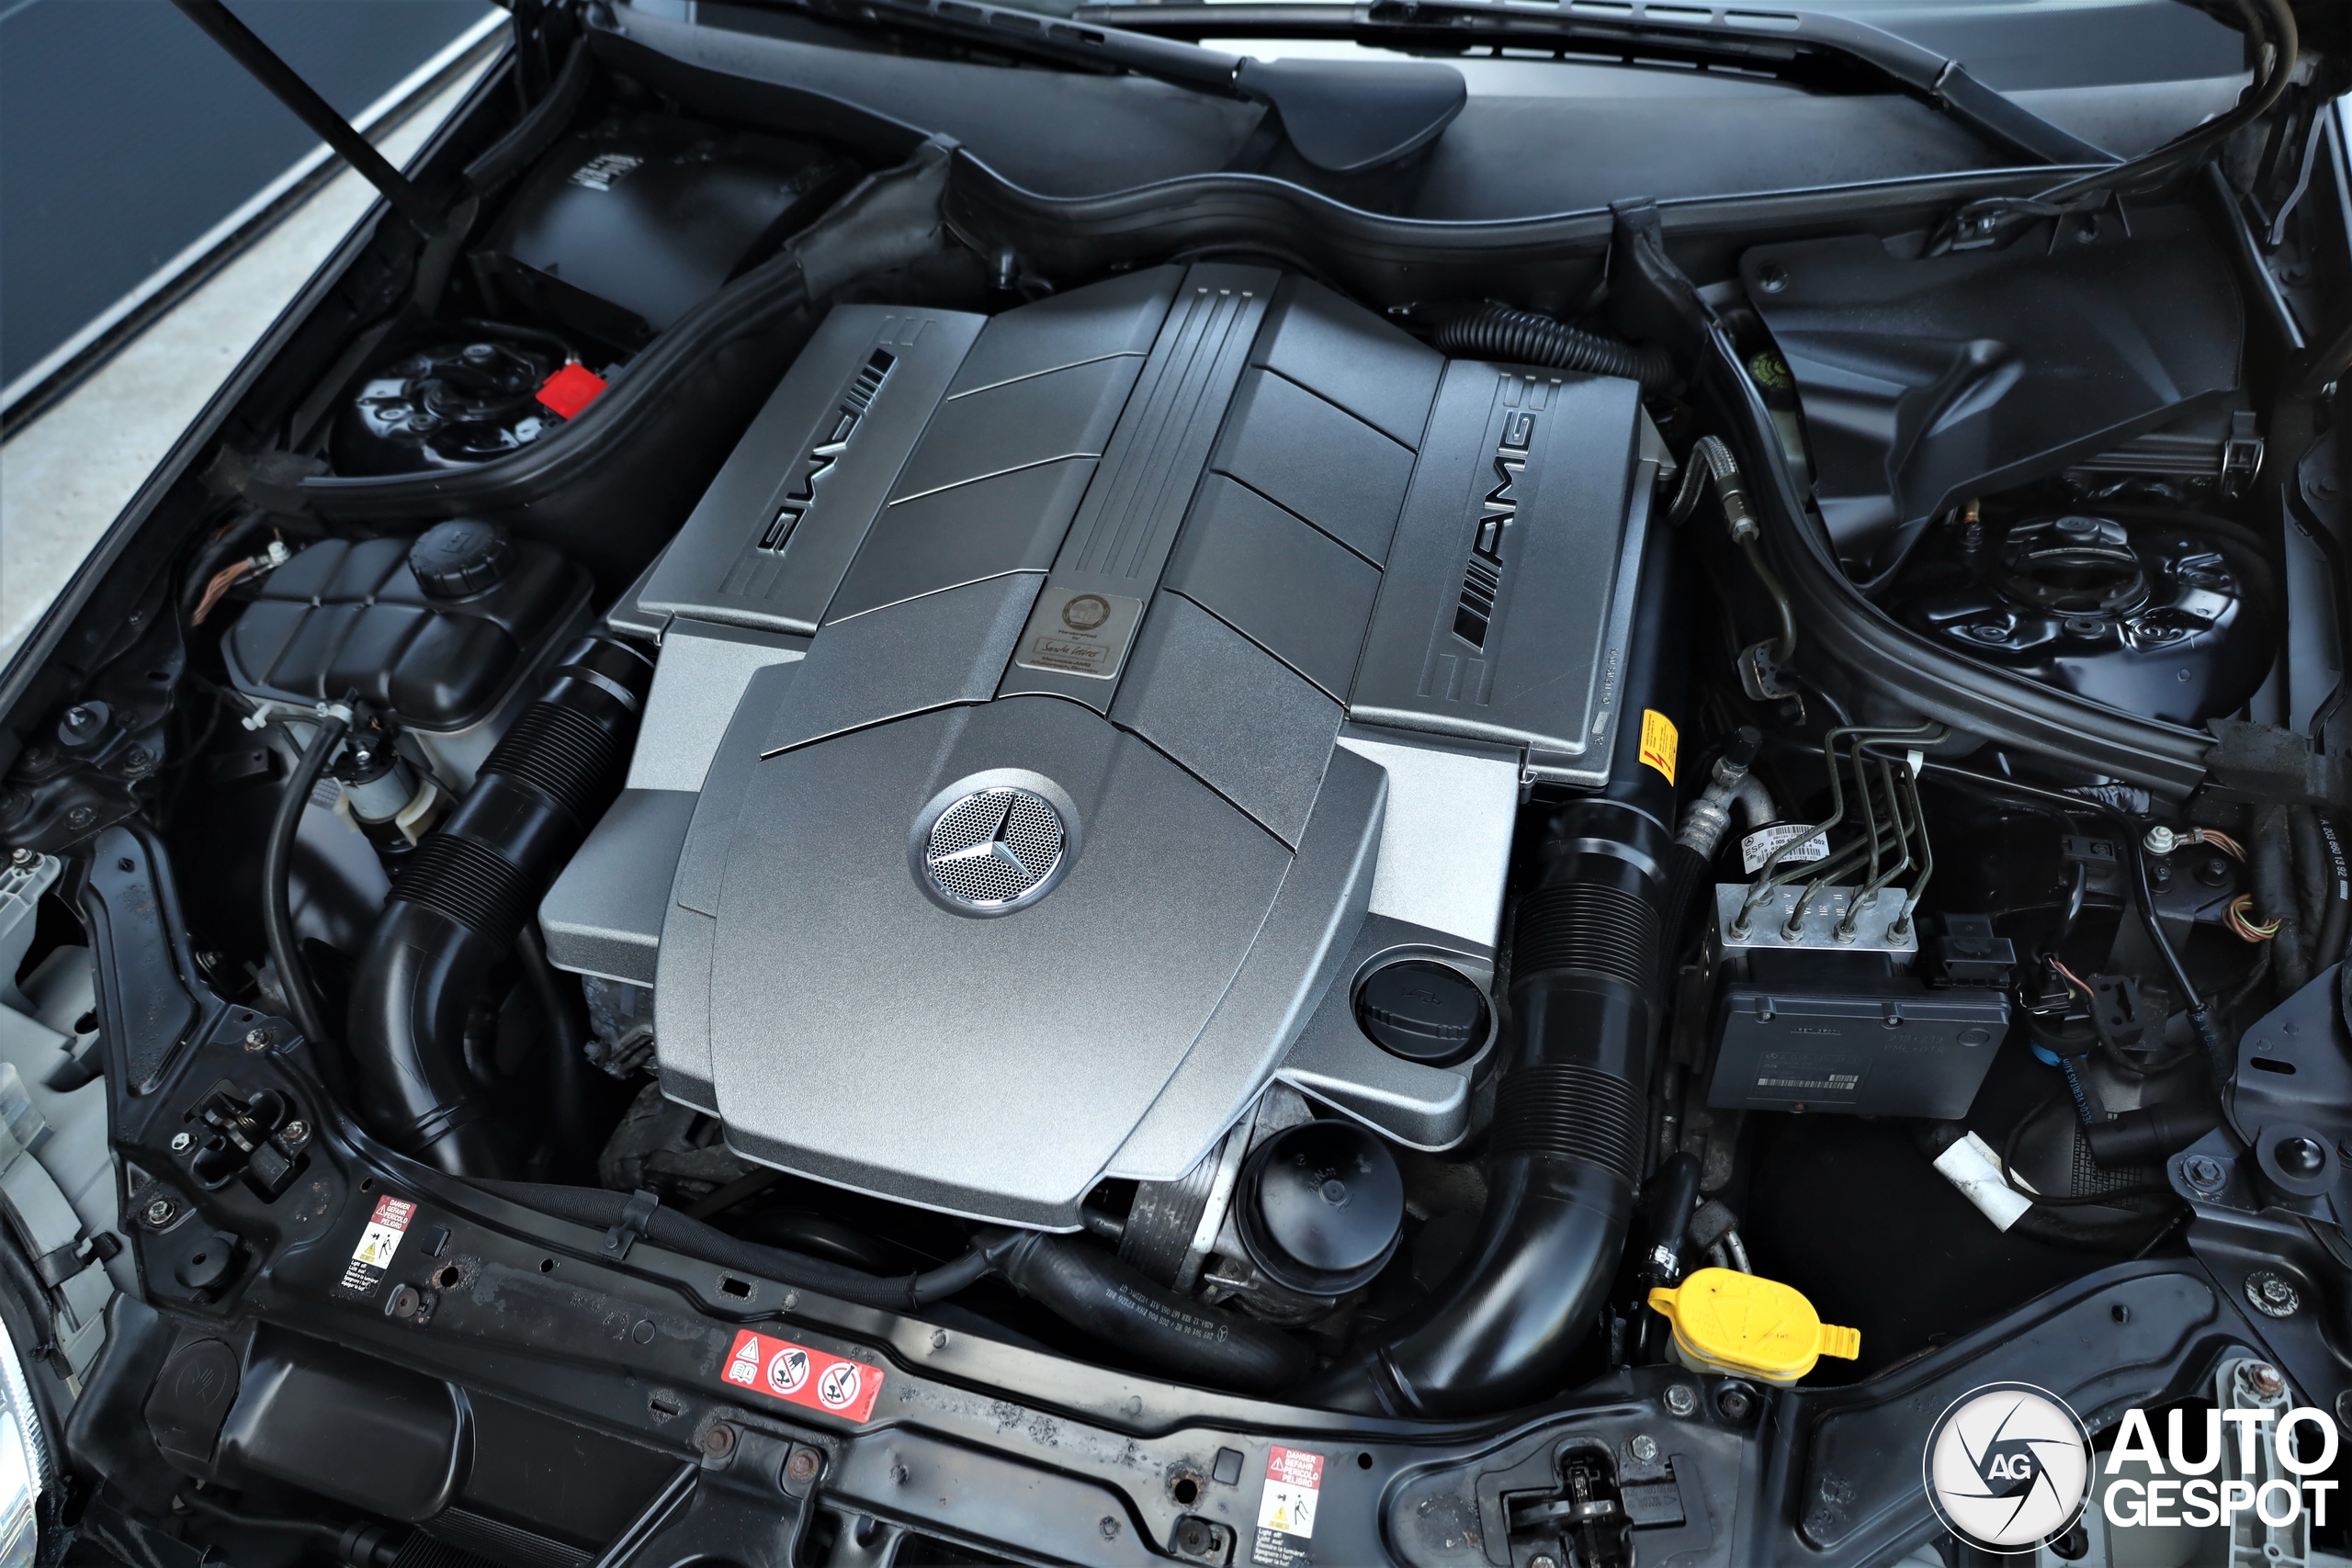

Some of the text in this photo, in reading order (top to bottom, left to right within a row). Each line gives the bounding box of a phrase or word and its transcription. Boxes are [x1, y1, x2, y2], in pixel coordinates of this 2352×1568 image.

[2323, 827, 2335, 840] 203
[1746, 842, 1764, 856] ESP
[2335, 856, 2345, 865] 13
[2337, 867, 2347, 877] 92
[2067, 1073, 2083, 1102] VERITAS
[387, 1206, 407, 1216] GEFAHR
[390, 1200, 411, 1211] DANGER
[380, 1218, 402, 1229] PELIGRO
[384, 1212, 408, 1224] PERICOLO
[1286, 1450, 1316, 1464] DANGER
[1285, 1459, 1314, 1472] GEFAHR
[1283, 1466, 1318, 1481] PERICOLO
[1283, 1473, 1313, 1487] PELIGRO
